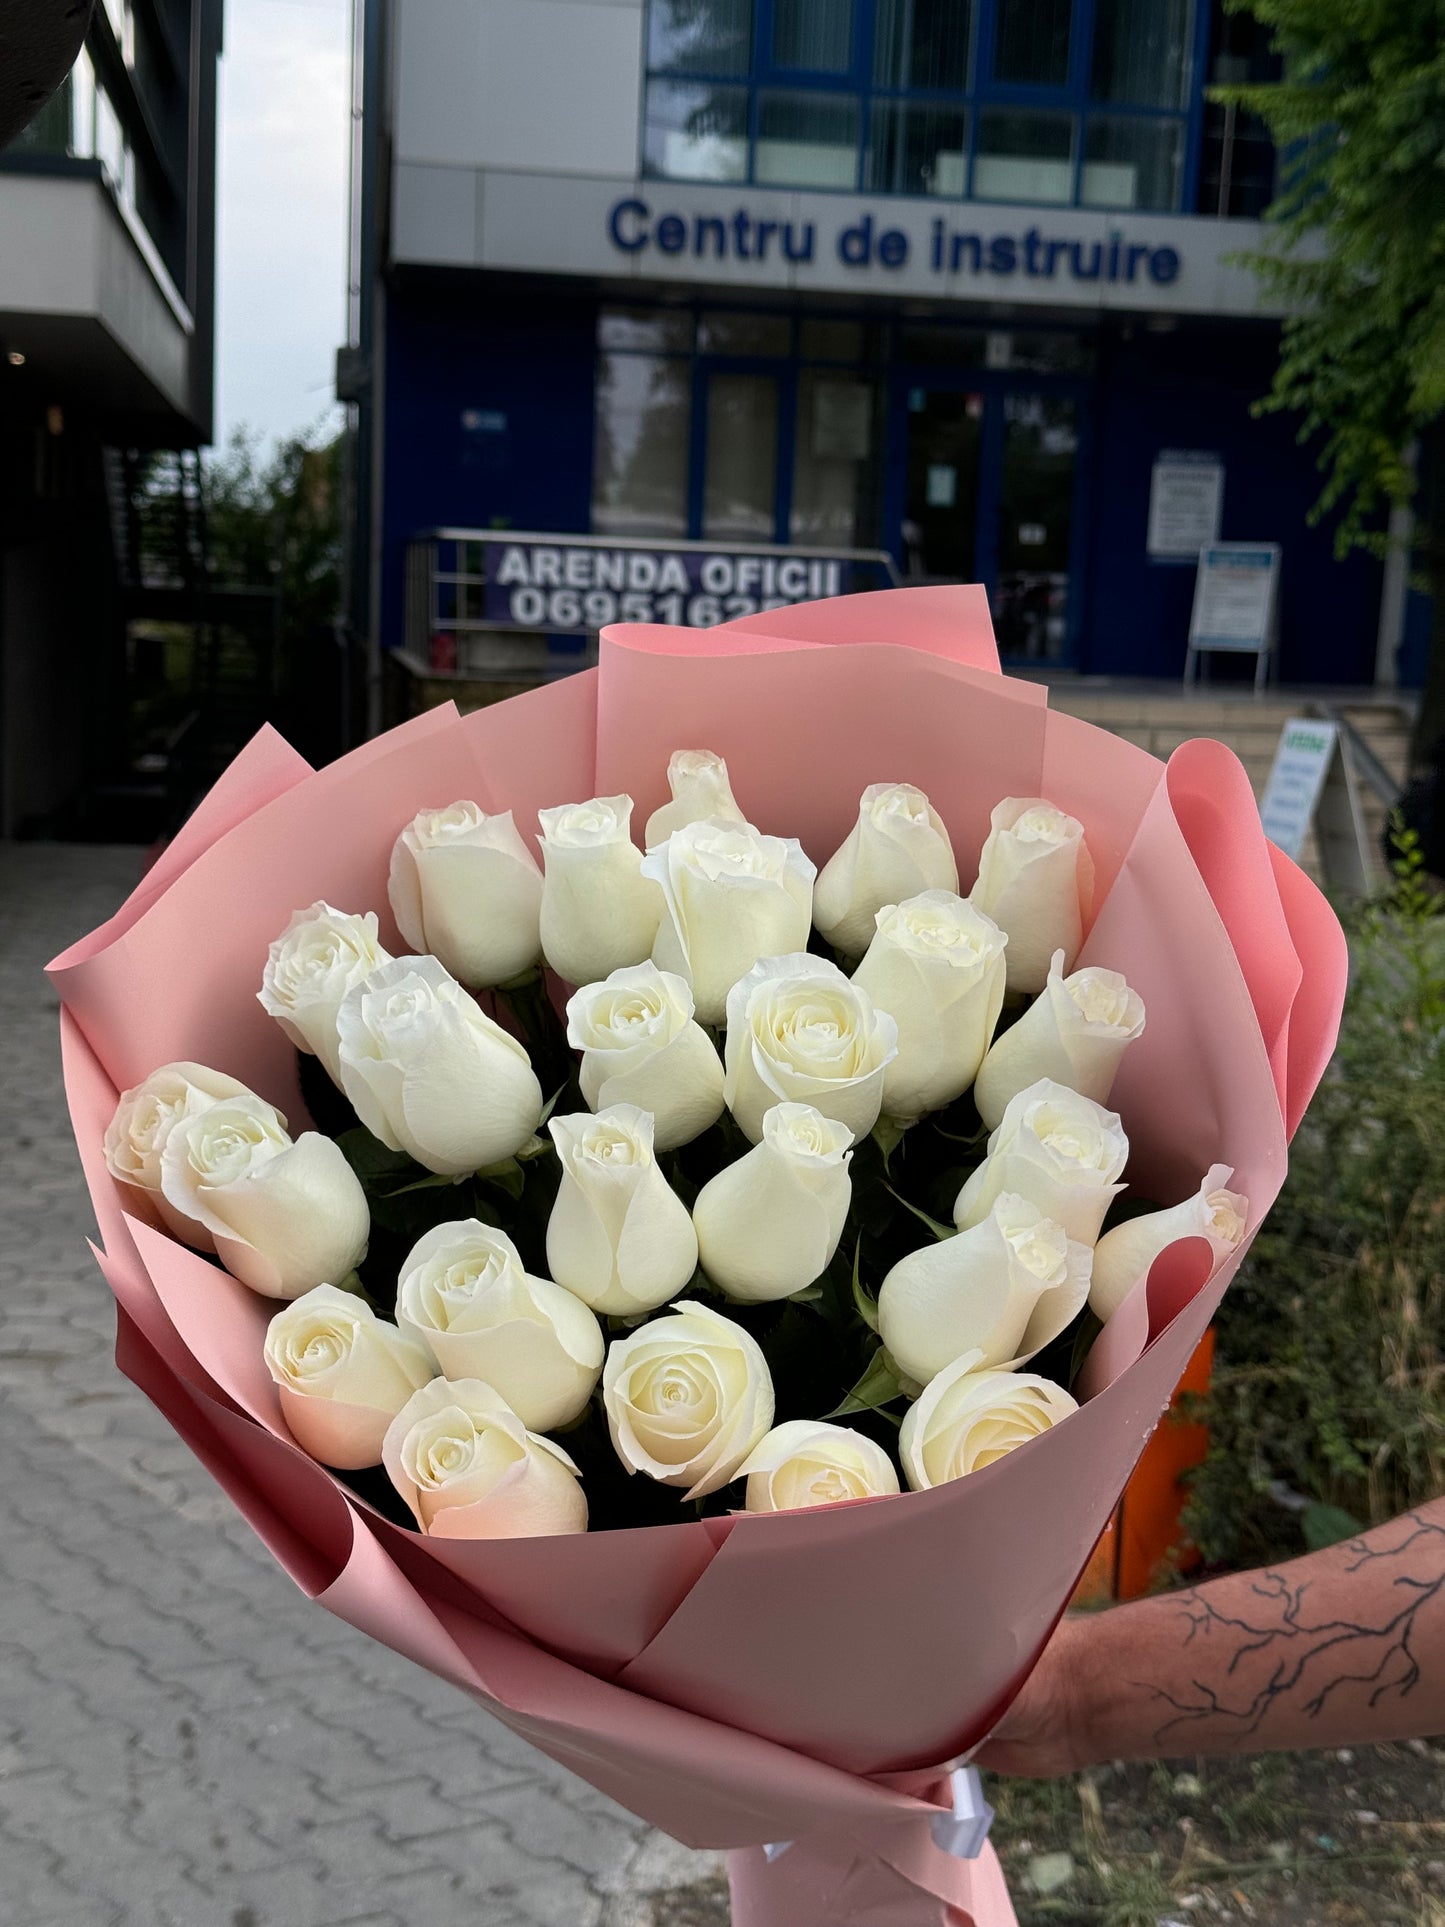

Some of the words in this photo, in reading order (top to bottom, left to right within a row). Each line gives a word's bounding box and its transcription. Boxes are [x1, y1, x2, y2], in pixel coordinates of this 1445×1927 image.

[609, 200, 814, 263] Centru
[838, 213, 909, 269] de
[932, 218, 1182, 285] instruire
[499, 546, 689, 590] ARENDA
[703, 557, 841, 597] OFICII
